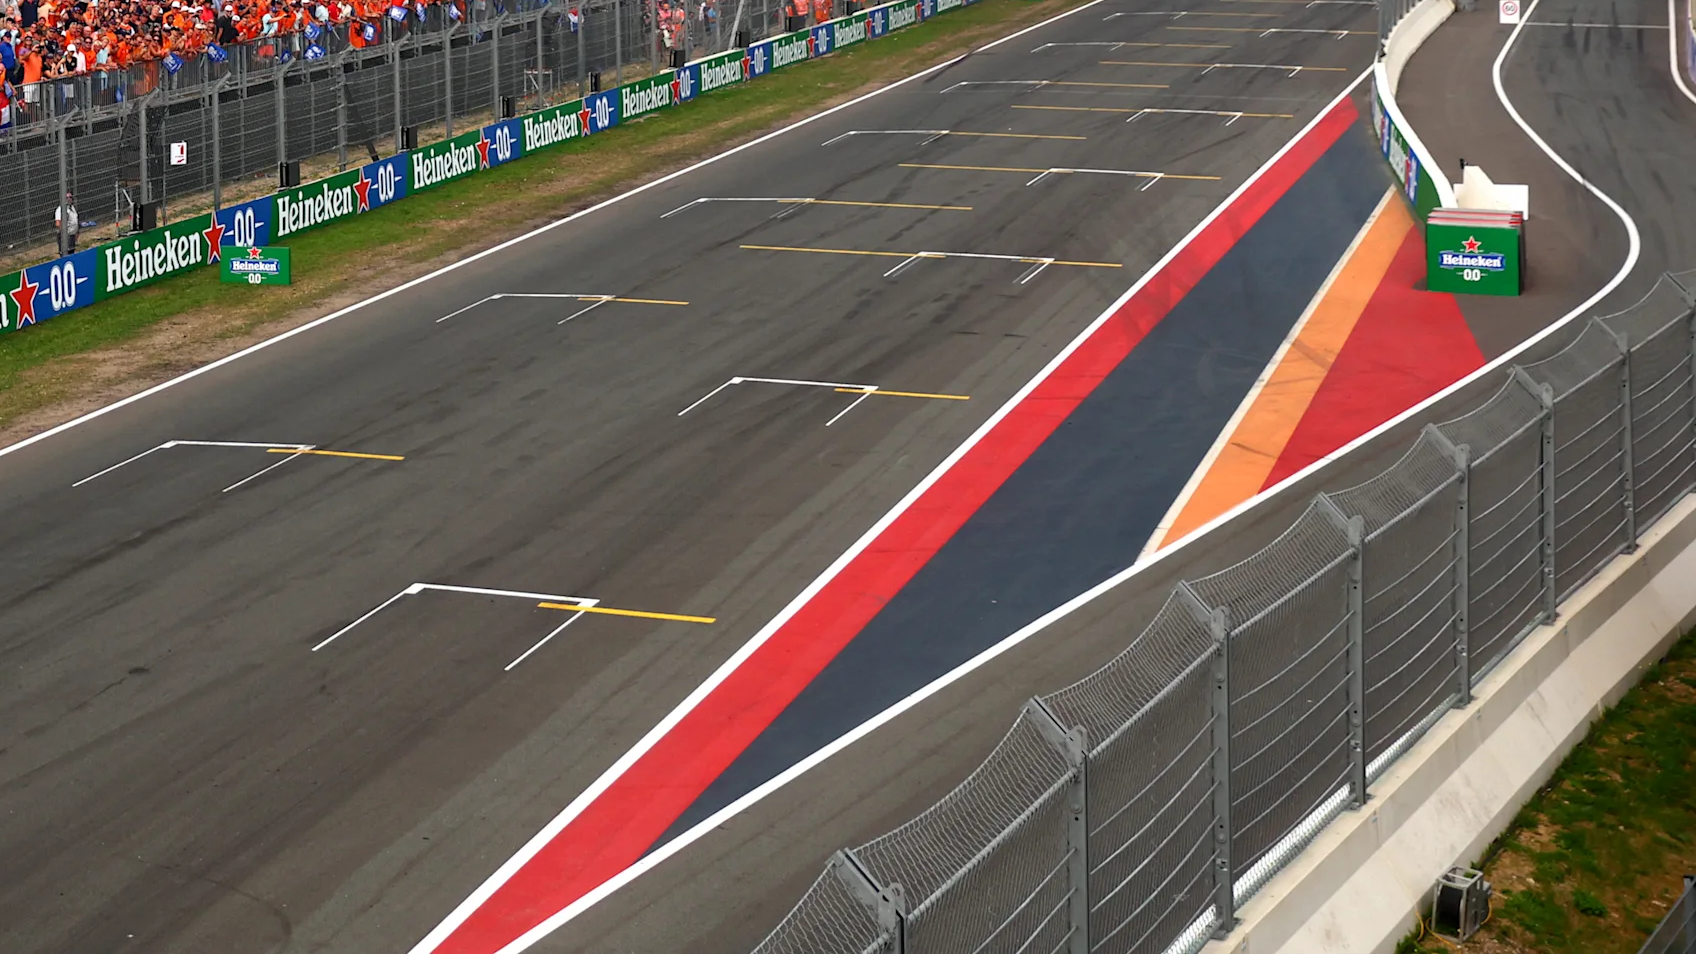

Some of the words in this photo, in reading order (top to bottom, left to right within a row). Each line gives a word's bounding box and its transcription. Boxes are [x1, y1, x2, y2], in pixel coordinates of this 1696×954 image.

[834, 18, 865, 48] Heineken
[773, 36, 808, 68] Heineken
[700, 57, 741, 91] Heineken
[622, 80, 669, 118] Heineken
[524, 109, 578, 151] Heineken
[595, 96, 610, 129] 0.0
[412, 141, 476, 189] Heineken
[496, 126, 511, 160] 0.0
[276, 181, 353, 237] Heineken
[377, 162, 395, 203] 0.0
[105, 230, 202, 293] Heineken
[231, 258, 279, 272] Heineken
[1442, 253, 1501, 268] Heineken
[1463, 269, 1481, 281] 0.0
[50, 260, 77, 311] 0.0
